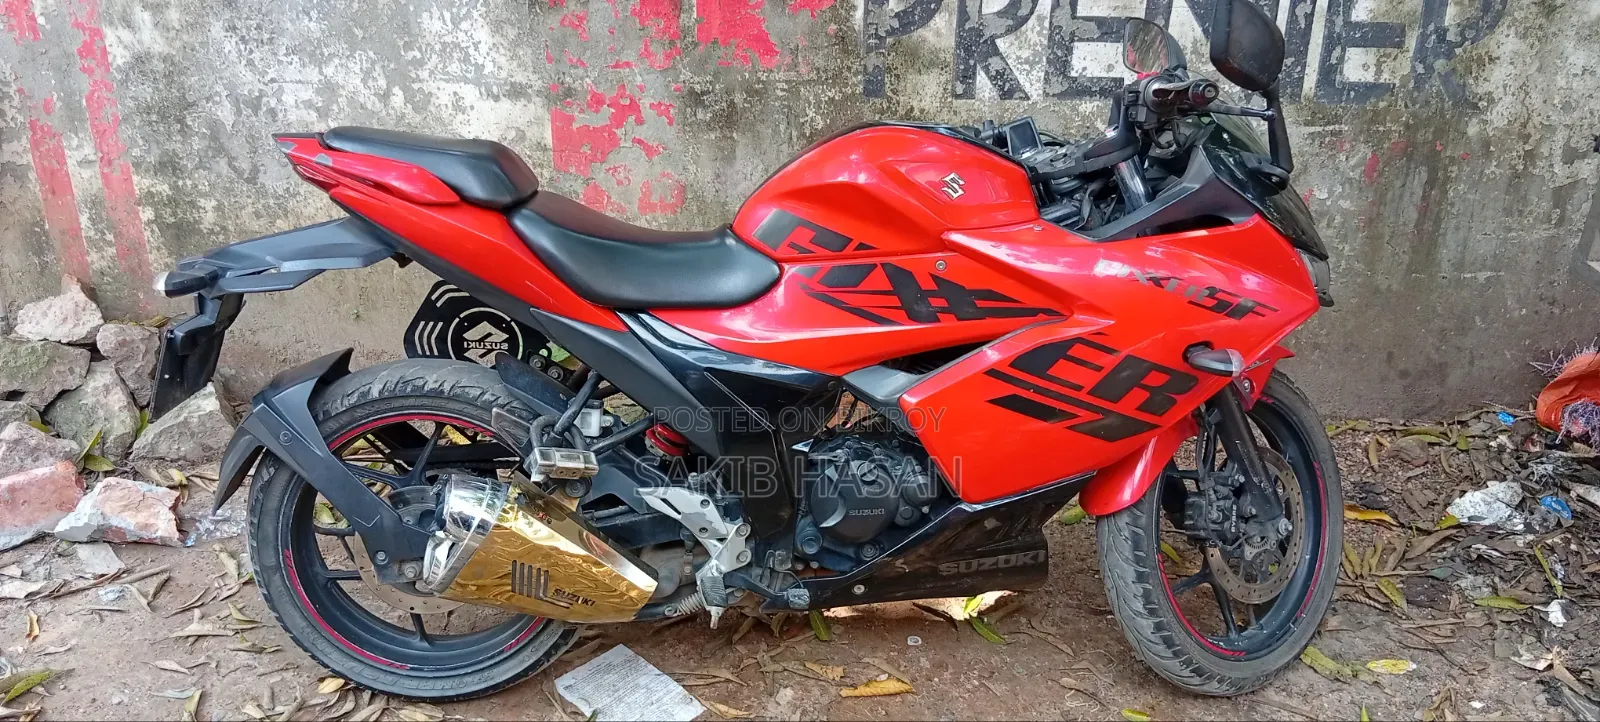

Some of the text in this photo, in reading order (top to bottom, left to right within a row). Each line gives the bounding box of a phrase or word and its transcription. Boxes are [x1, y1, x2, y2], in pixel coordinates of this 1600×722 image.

[848, 508, 885, 516] SUZUKI
[938, 549, 1047, 576] SUZUKI
[552, 587, 596, 607] SUZUKI
